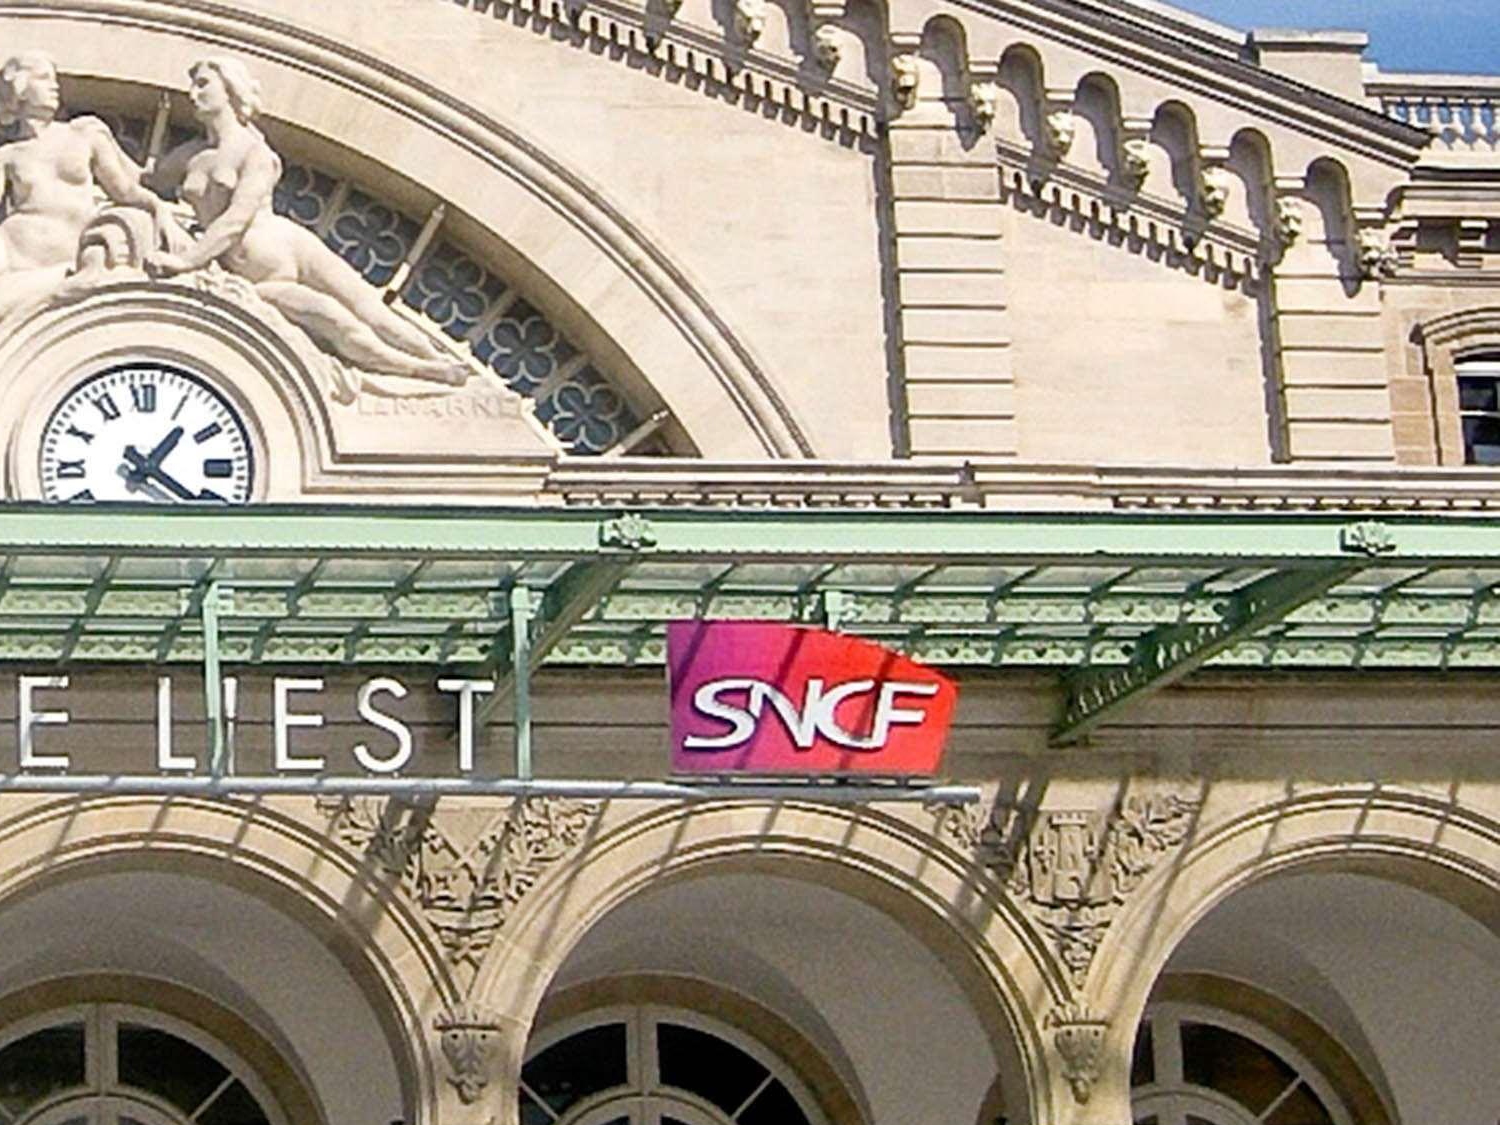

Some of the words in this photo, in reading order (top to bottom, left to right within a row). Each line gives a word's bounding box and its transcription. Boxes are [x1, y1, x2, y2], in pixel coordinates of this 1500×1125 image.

[130, 383, 157, 412] XII
[66, 424, 94, 444] X
[157, 675, 496, 771] L'EST
[682, 678, 939, 750] SNCF
